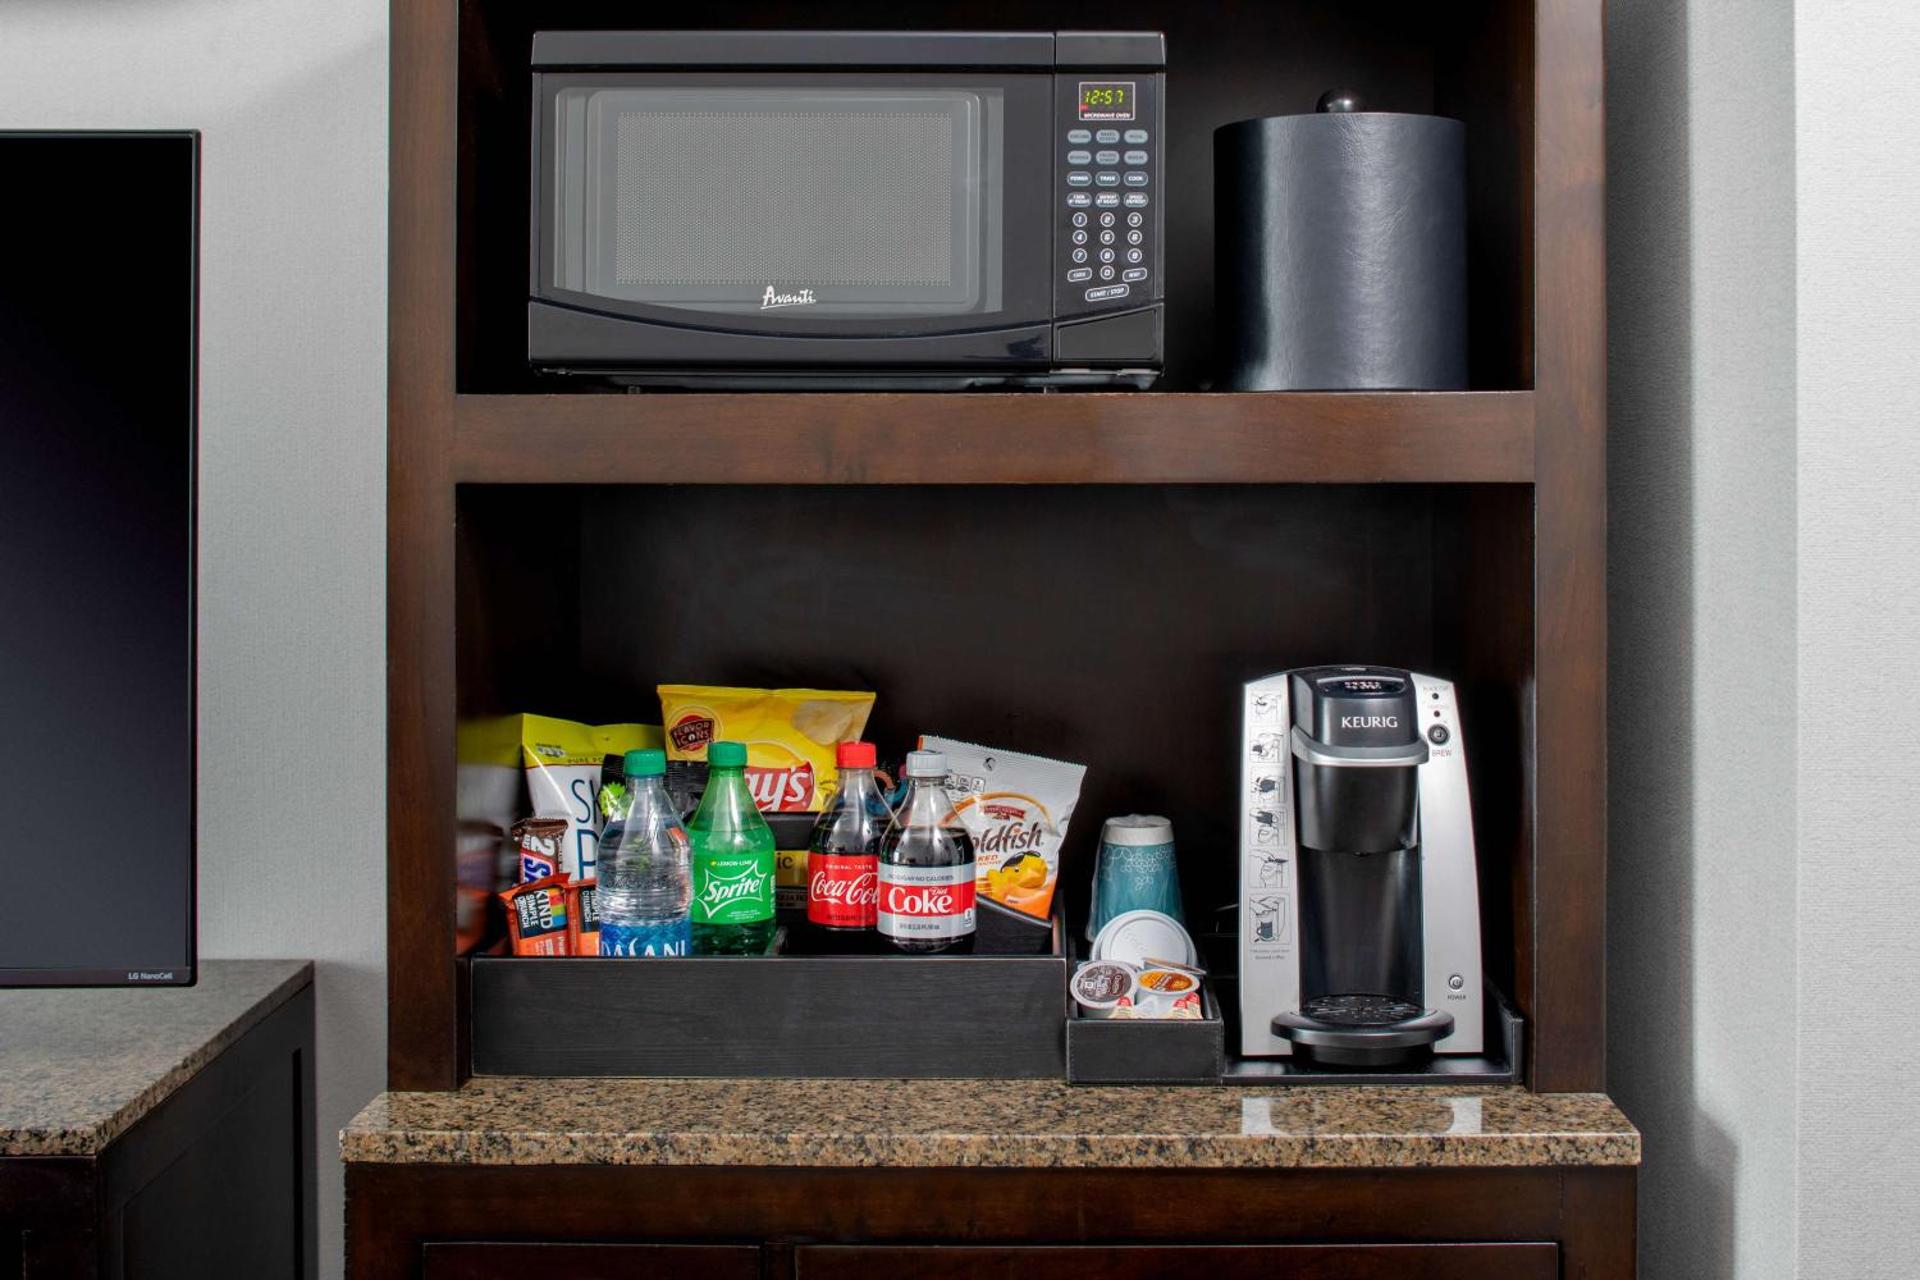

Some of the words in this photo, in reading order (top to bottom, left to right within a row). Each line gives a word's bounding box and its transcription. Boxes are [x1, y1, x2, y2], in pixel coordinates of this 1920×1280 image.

[1084, 89, 1125, 104] 12:57
[1077, 233, 1084, 241] 4
[1076, 251, 1084, 260] 7
[761, 285, 817, 308] Avanti
[674, 721, 711, 737] FLAVOR
[1341, 716, 1398, 728] KEURIG
[1431, 749, 1453, 757] BREW
[744, 766, 810, 812] ay's
[972, 822, 1042, 853] oldfish
[977, 855, 999, 863] KED
[704, 875, 761, 903] Sprite
[811, 871, 878, 905] Coca-Col
[525, 895, 540, 928] SIMPLE
[536, 889, 554, 930] KIND
[887, 886, 954, 914] Coke
[516, 895, 531, 929] CRUNCH
[128, 972, 139, 980] LG
